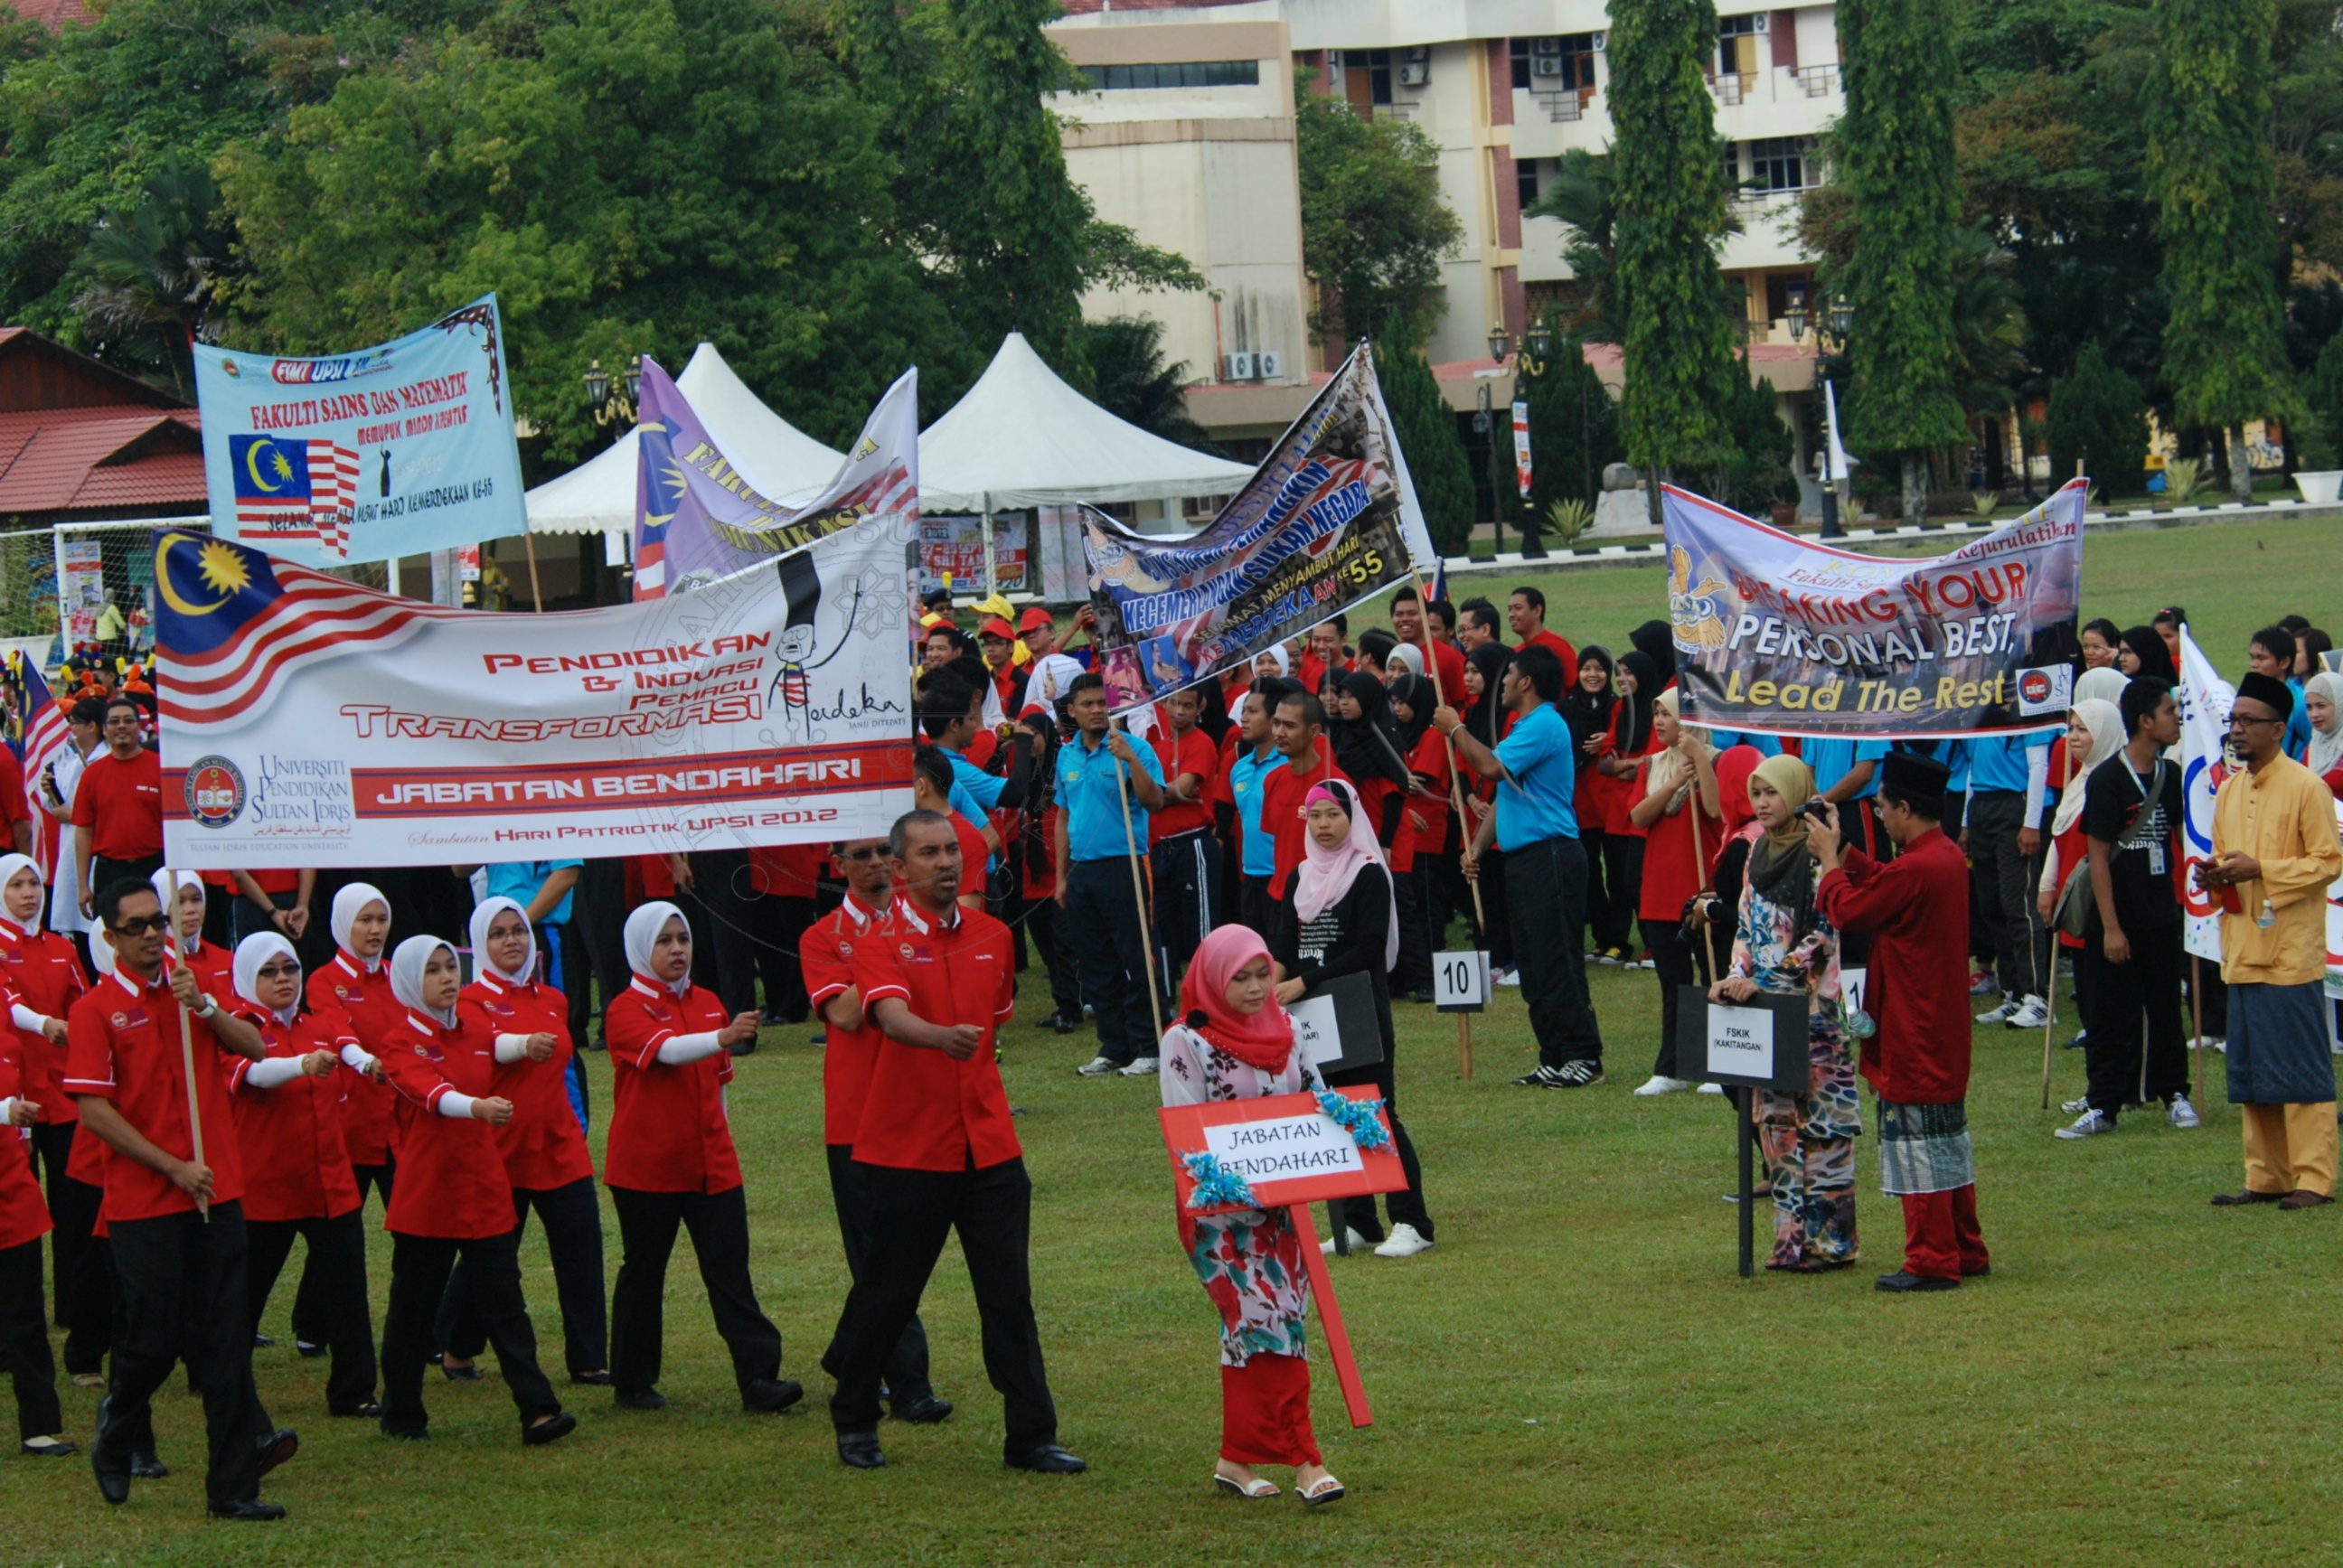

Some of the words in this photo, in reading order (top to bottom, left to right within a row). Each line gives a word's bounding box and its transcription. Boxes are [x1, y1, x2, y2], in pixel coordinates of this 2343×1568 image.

[311, 361, 345, 381] UPSI
[250, 400, 319, 429] FAKULTI
[321, 393, 369, 422] SAINS
[370, 387, 400, 415] DAN
[398, 371, 468, 409] MATEMATIK
[357, 420, 402, 446] MEMUPUK
[1122, 567, 1255, 634] KECEMERLANGAN
[1243, 517, 1316, 580] SUKAN
[1308, 475, 1372, 537] NEGARA
[1192, 601, 1261, 643] SELAMAT
[1260, 551, 1334, 606] MENYAMBUT
[1336, 534, 1360, 559] HARI
[1727, 567, 1898, 625] BREAKING
[1901, 561, 2027, 616] YOUR
[1786, 568, 1849, 588] Fakulti
[1196, 575, 1337, 664] KEMERDEKAAN
[1337, 566, 1350, 582] KE
[1349, 549, 1383, 584] 55
[482, 631, 771, 675] PENDIDIKAN
[1727, 614, 1934, 666] PERSONAL
[1942, 612, 2017, 659] BEST,
[581, 675, 622, 692] &
[629, 677, 758, 710] PEMACU
[1725, 669, 1845, 712] Lead
[1856, 679, 1922, 713] The
[1934, 670, 2005, 710] Rest
[340, 693, 763, 743] TRANSFORMASI
[849, 720, 869, 729] JANJI
[259, 756, 346, 780] UNIVERSITI
[376, 779, 585, 804] JABATAN
[591, 758, 861, 797] BENDAHARI
[259, 776, 348, 802] PENDIDIKAN
[251, 795, 309, 823] SULTAN
[313, 799, 351, 823] IDRIS
[408, 831, 491, 847] Sambutan
[494, 829, 551, 841] HARI
[557, 822, 680, 839] PATRIOTIK
[686, 815, 754, 831] UPSI
[761, 808, 839, 825] 2012
[190, 844, 220, 852] SULTAN
[223, 843, 248, 851] IDRIS
[250, 842, 299, 850] EDUCATION
[301, 842, 349, 850] UNIVERSITY
[1444, 961, 1470, 995] 10
[1714, 1039, 1764, 1053] (KAKITANGAN)
[1727, 1027, 1751, 1039] FSKIK
[1227, 1122, 1322, 1150] JABATAN
[1219, 1146, 1351, 1177] BENDAHARI
